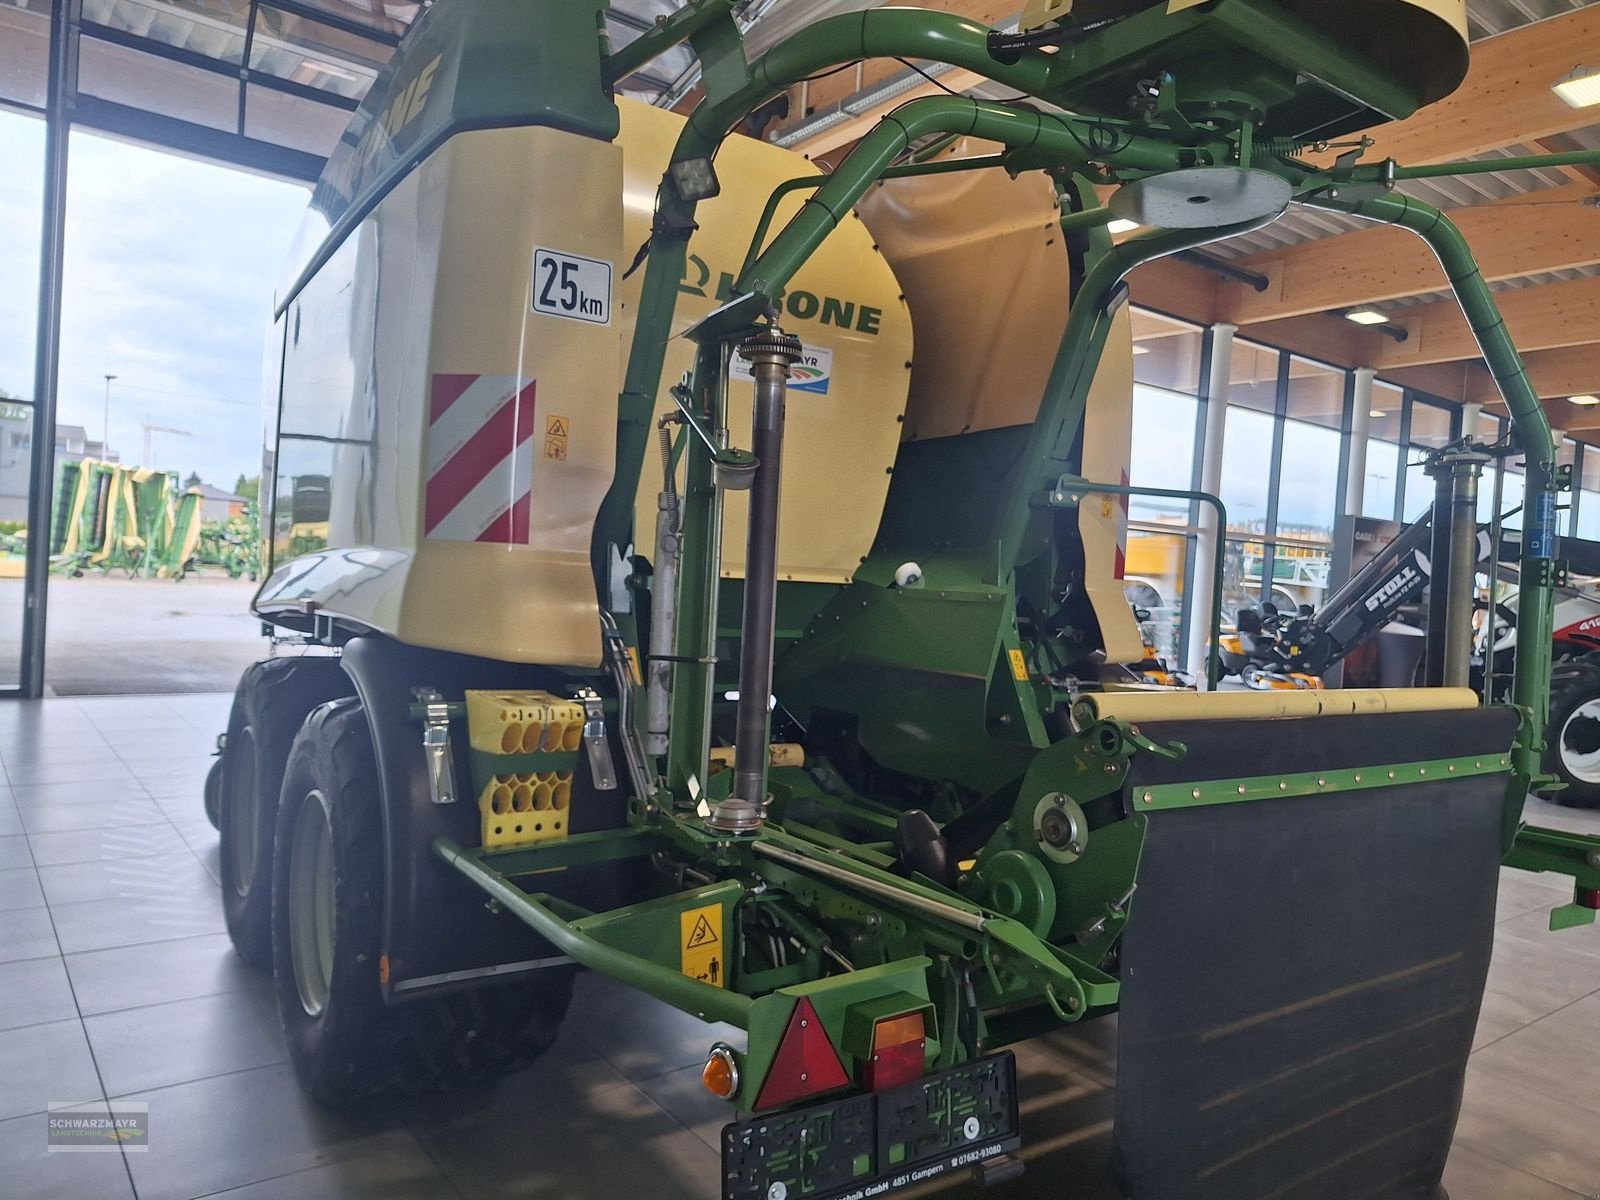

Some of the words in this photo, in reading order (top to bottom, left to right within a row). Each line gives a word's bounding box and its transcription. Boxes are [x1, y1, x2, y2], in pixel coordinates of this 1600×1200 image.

[1364, 566, 1417, 612] STOLL
[865, 1181, 889, 1197] GmbH
[892, 1174, 910, 1187] 4851
[911, 1164, 944, 1181] Gampern
